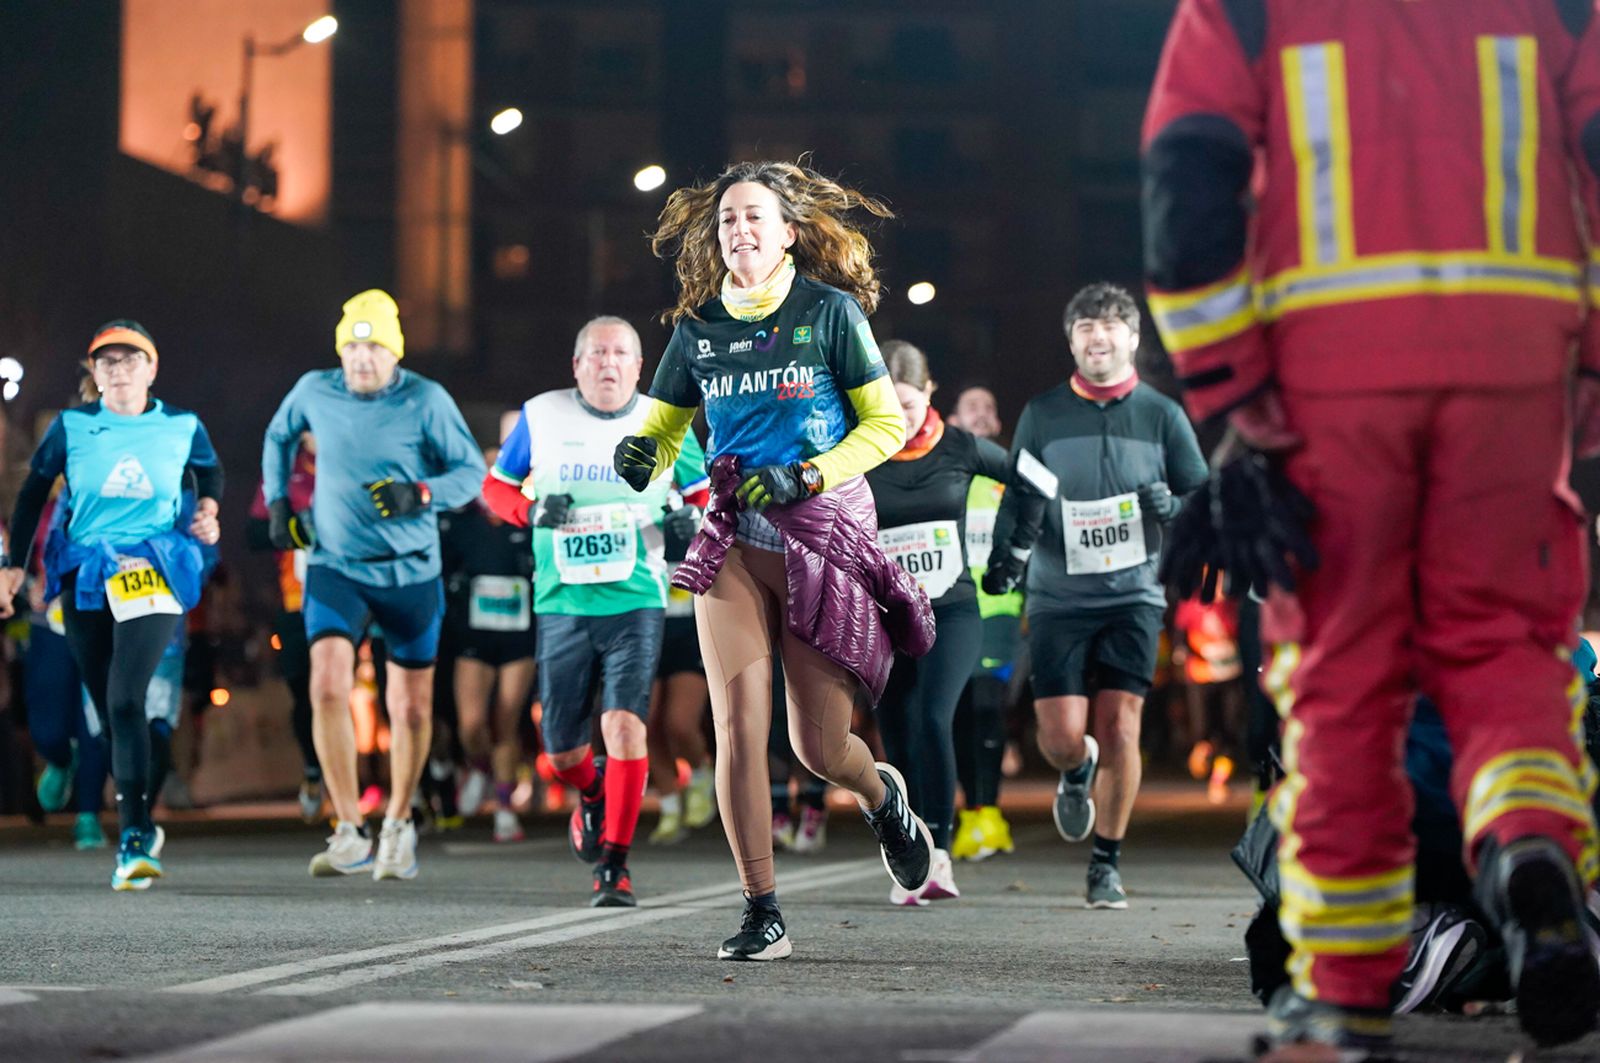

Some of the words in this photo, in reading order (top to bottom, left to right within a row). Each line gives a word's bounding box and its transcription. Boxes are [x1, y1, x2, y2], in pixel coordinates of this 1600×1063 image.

[701, 375, 733, 400] SAN
[739, 360, 814, 394] ANTÓN
[777, 381, 815, 400] 2025
[1080, 523, 1129, 548] 4606
[896, 550, 943, 574] 4607
